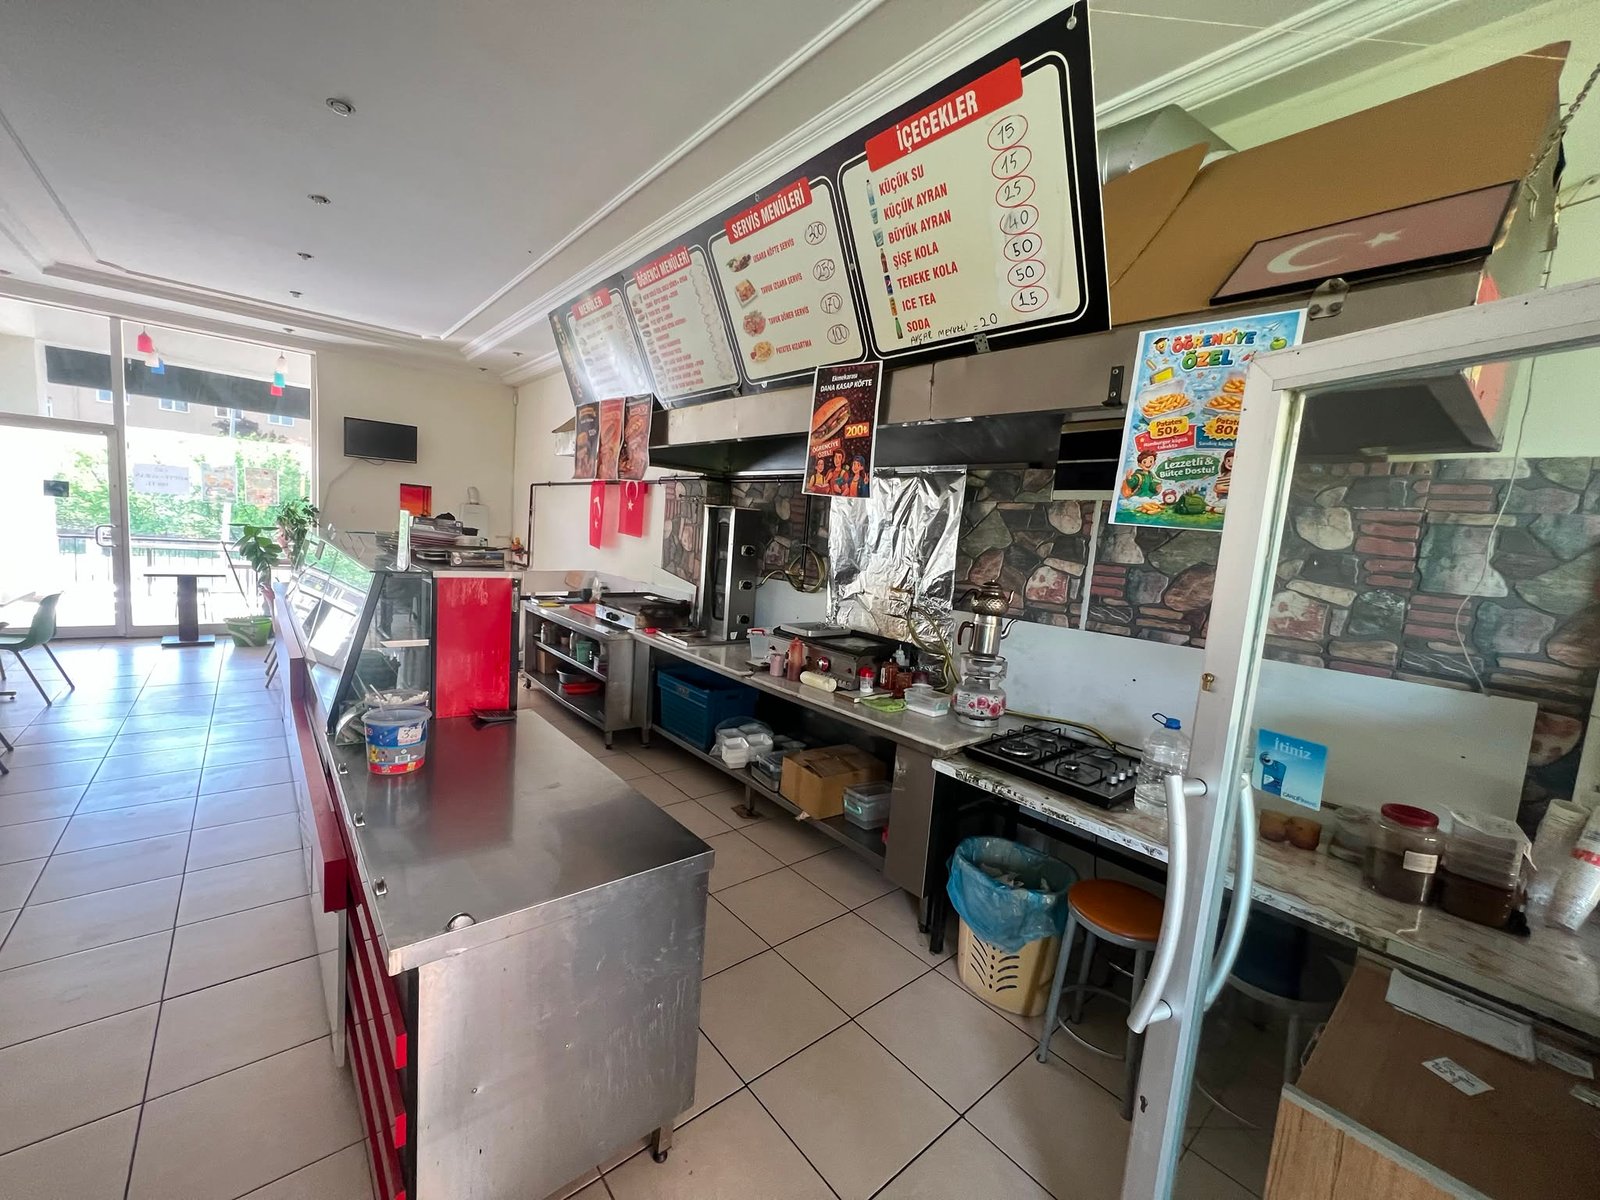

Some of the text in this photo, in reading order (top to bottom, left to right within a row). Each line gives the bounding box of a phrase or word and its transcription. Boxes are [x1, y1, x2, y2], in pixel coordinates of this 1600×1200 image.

[896, 90, 978, 153] İÇECEKLER
[997, 122, 1015, 144] 15
[1001, 150, 1017, 173] 15
[879, 164, 925, 194] KÜÇÜK SU
[1004, 179, 1021, 201] 25
[731, 183, 805, 239] SERVİS MENÜLERİ
[883, 182, 948, 219] KÜÇÜK AYRAN
[888, 209, 952, 244] BÜYÜK AYRAN
[892, 241, 939, 270] ŞİŞE KOLA
[1012, 239, 1033, 257] 50
[897, 261, 958, 289] TENEKE KOLA
[1015, 265, 1035, 281] 50
[902, 292, 937, 311] ICE TEA
[1019, 291, 1038, 307] 15
[906, 318, 931, 333] SODA
[1172, 329, 1257, 353] ÖĞRENCİYE
[1181, 349, 1234, 371] ÖZEL
[836, 382, 853, 390] KASAP
[853, 379, 873, 388] KÖFTE
[1156, 419, 1182, 427] Patates
[1160, 466, 1216, 478] Bütçe Dostu!
[1164, 457, 1214, 470] Lezzetli &
[1274, 737, 1313, 760] İtiniz
